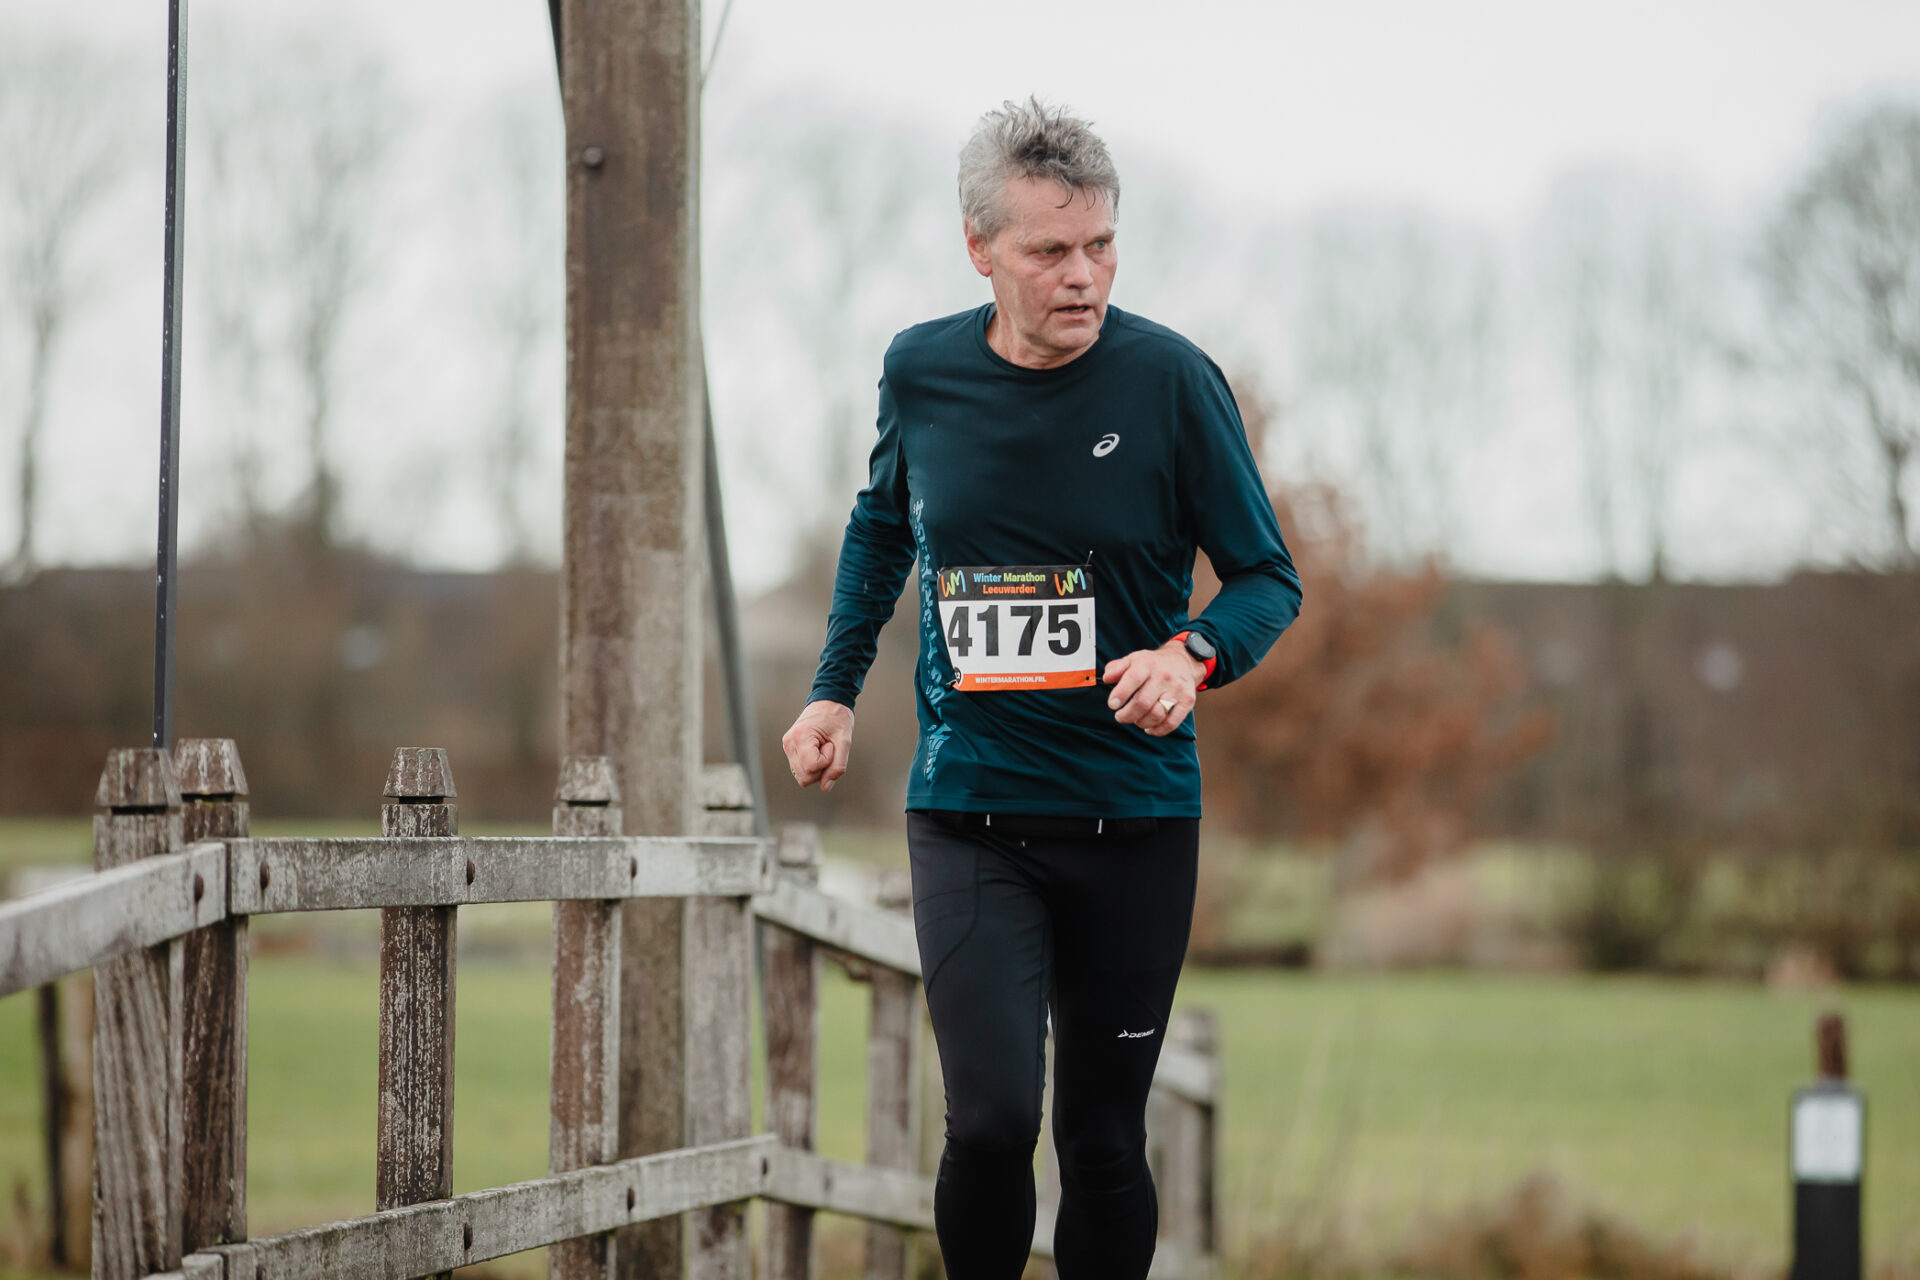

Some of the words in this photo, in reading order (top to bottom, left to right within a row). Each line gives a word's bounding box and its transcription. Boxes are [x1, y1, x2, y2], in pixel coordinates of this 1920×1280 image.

[973, 572, 1002, 583] Winter
[1003, 572, 1047, 583] Marathon
[982, 584, 1037, 595] Leeuwarden
[947, 604, 1082, 657] 4175
[974, 675, 1047, 685] WINTERMARATHON.FRL
